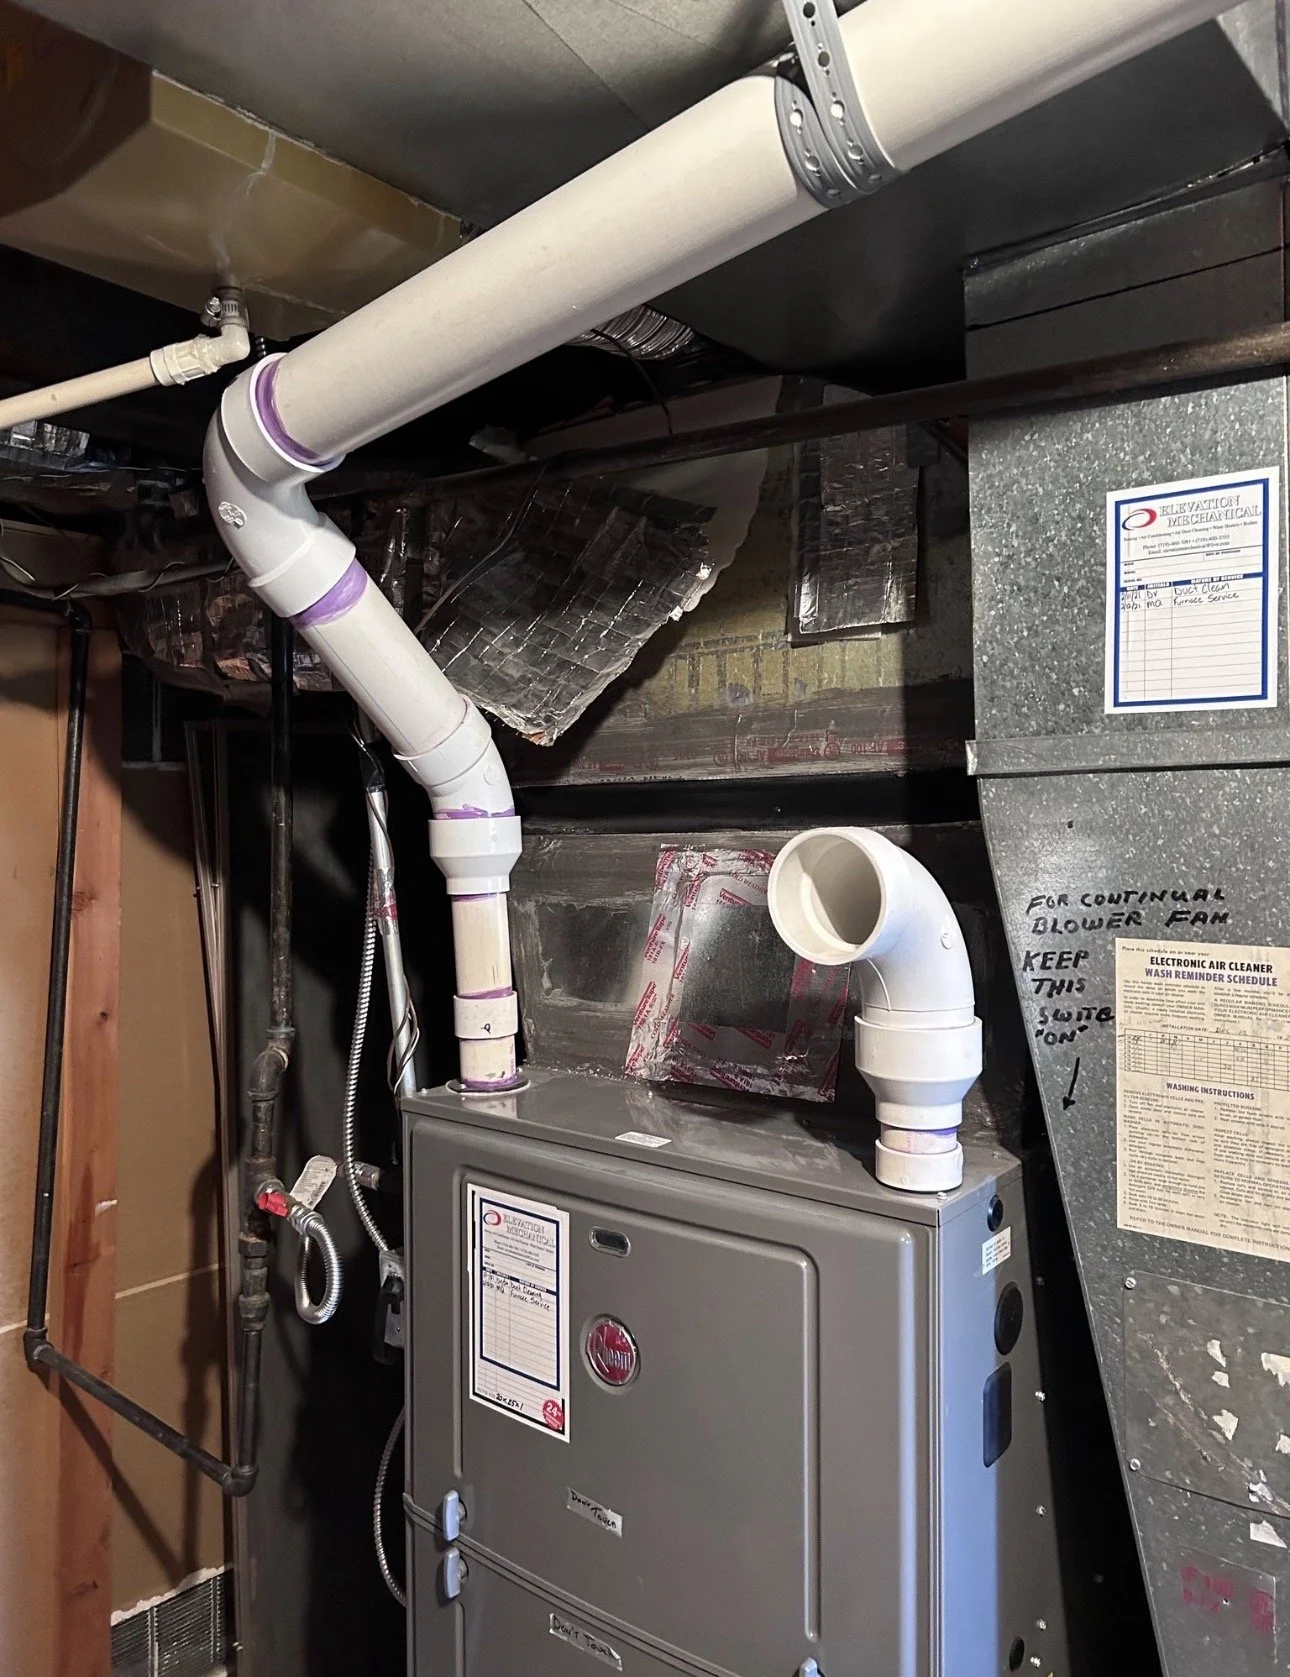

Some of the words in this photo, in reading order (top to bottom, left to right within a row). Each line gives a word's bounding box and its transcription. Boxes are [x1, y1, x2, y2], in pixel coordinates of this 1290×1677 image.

[1160, 495, 1240, 516] ELEVATION
[1168, 505, 1262, 528] MECHANICAL
[1026, 893, 1069, 916] FOR
[1081, 888, 1225, 908] CONTINUAL
[1031, 911, 1143, 935] BLOWER
[1164, 910, 1230, 928] FAN
[1022, 950, 1089, 972] KEEP
[1150, 956, 1207, 969] ELECTRONIC
[1208, 960, 1226, 970] AIR
[1229, 961, 1273, 974] CLEANER
[1031, 977, 1087, 999] THIS
[1145, 968, 1172, 978] WASH
[1175, 970, 1224, 983] REMINDER
[1227, 974, 1278, 987] SCHEDULE
[1166, 1082, 1200, 1093] WASHING
[1200, 1087, 1255, 1100] INSTRUCTIONS
[592, 1326, 631, 1373] Rheem
